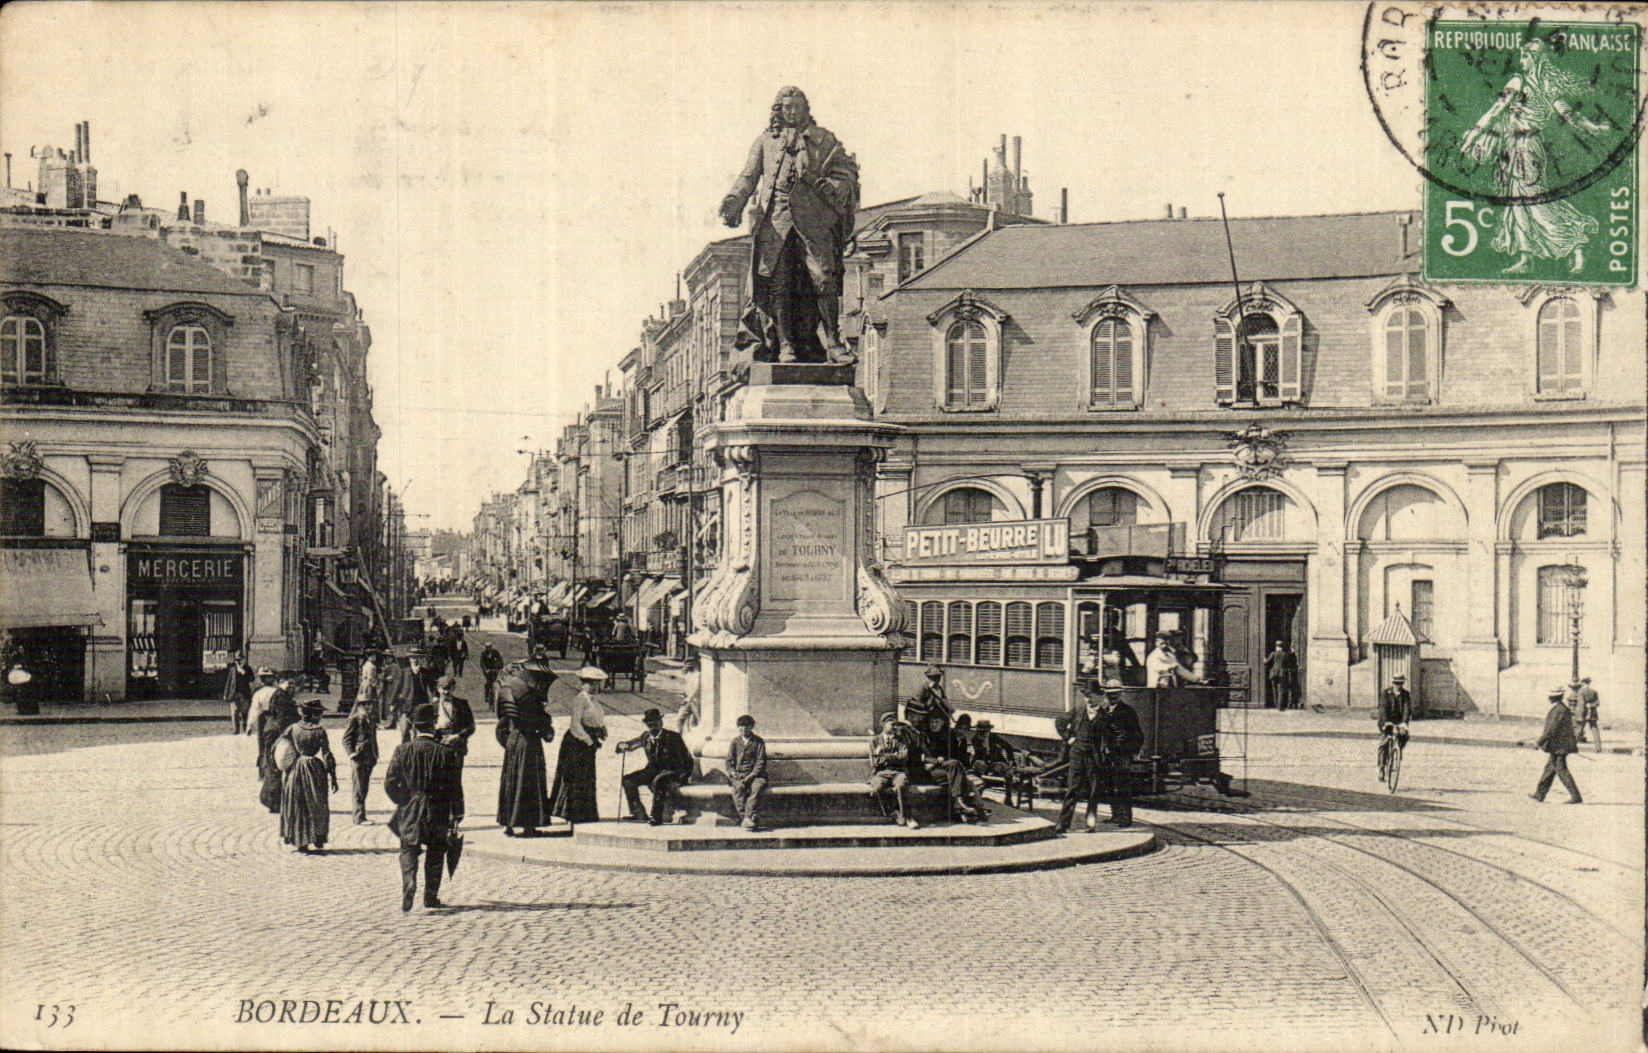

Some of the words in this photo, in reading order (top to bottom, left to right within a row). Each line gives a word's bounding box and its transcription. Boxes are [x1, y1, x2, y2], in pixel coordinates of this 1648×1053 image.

[1609, 185, 1630, 273] POSTES
[791, 545, 837, 556] TOURNY
[906, 525, 1038, 560] PETIT-BEURRE
[1044, 523, 1066, 557] LU
[138, 559, 234, 578] MERCERIE
